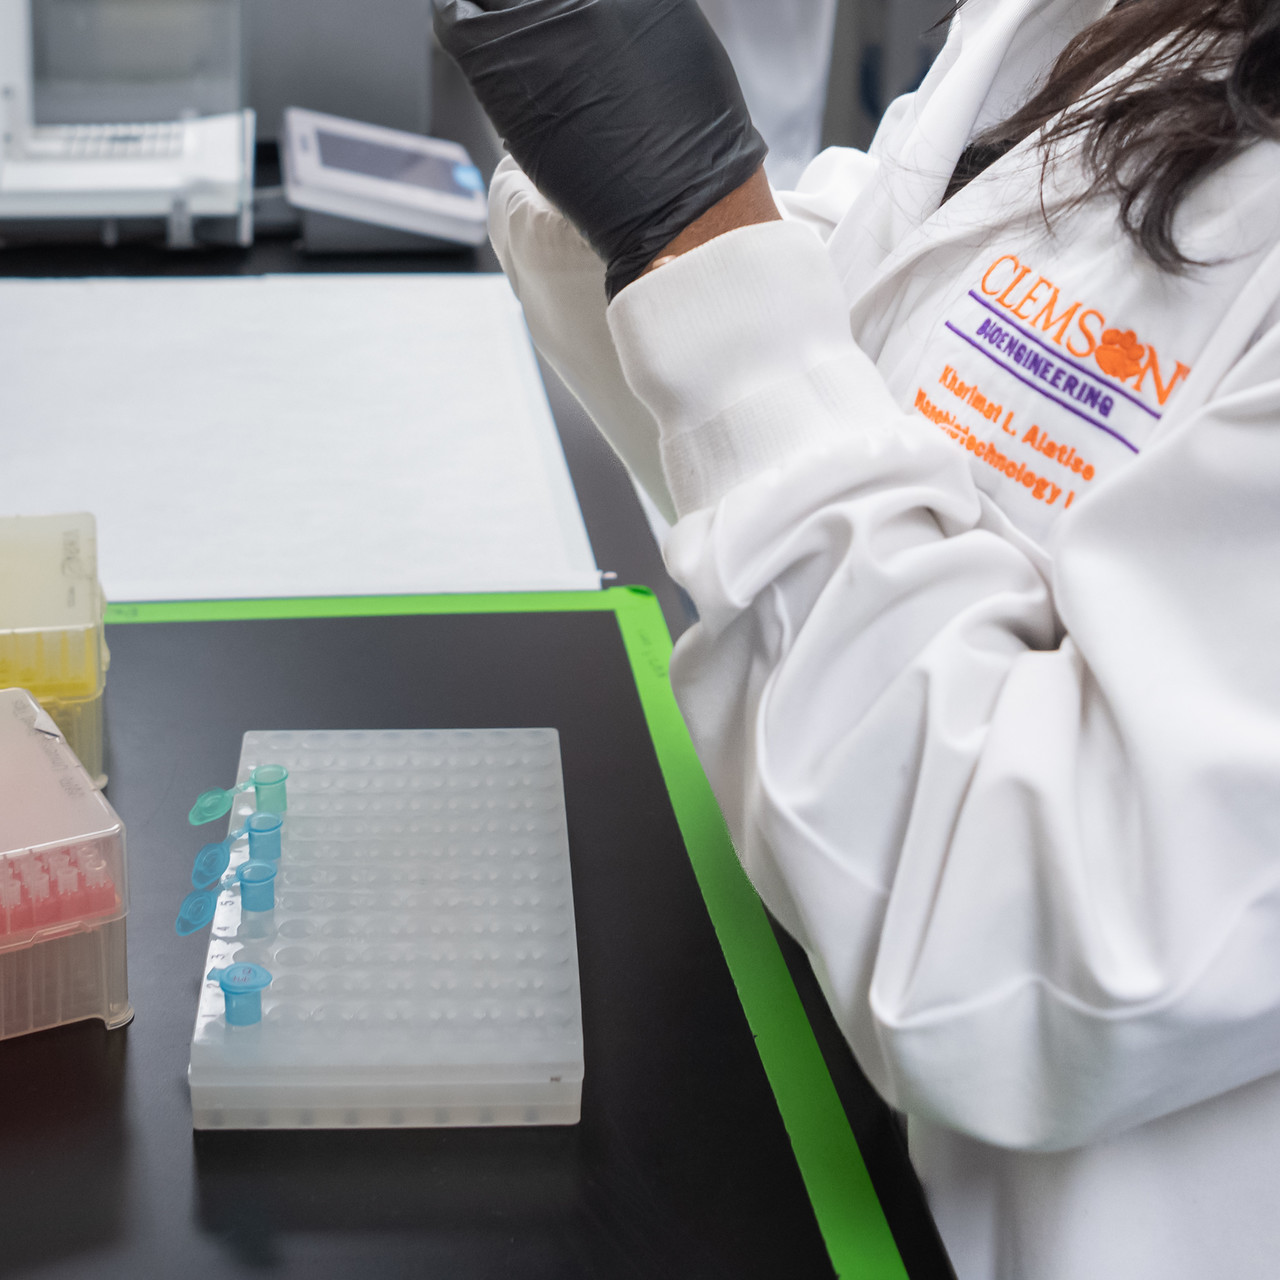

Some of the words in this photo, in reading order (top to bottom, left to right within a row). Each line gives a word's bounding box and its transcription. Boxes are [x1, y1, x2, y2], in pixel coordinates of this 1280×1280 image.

[976, 317, 1115, 418] BIOENGINEERING
[913, 387, 1062, 506] Nanobiotechnology
[1002, 411, 1017, 437] L.
